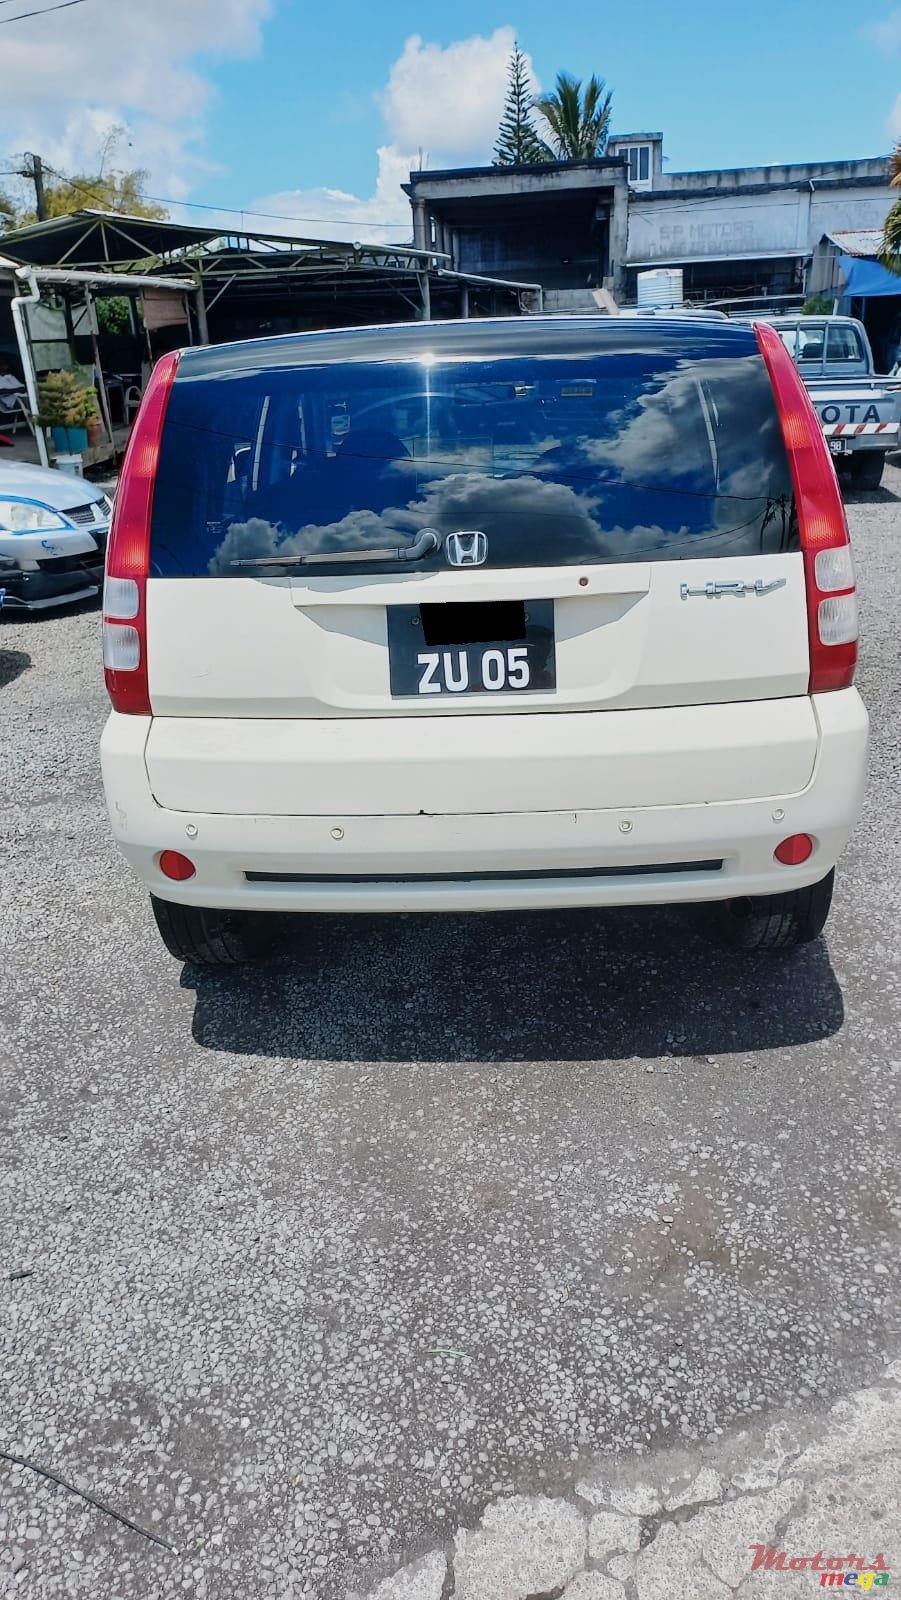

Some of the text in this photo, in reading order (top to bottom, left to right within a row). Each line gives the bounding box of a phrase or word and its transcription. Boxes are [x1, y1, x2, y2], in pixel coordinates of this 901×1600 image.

[821, 404, 881, 424] OTA
[417, 647, 530, 694] ZU 05
